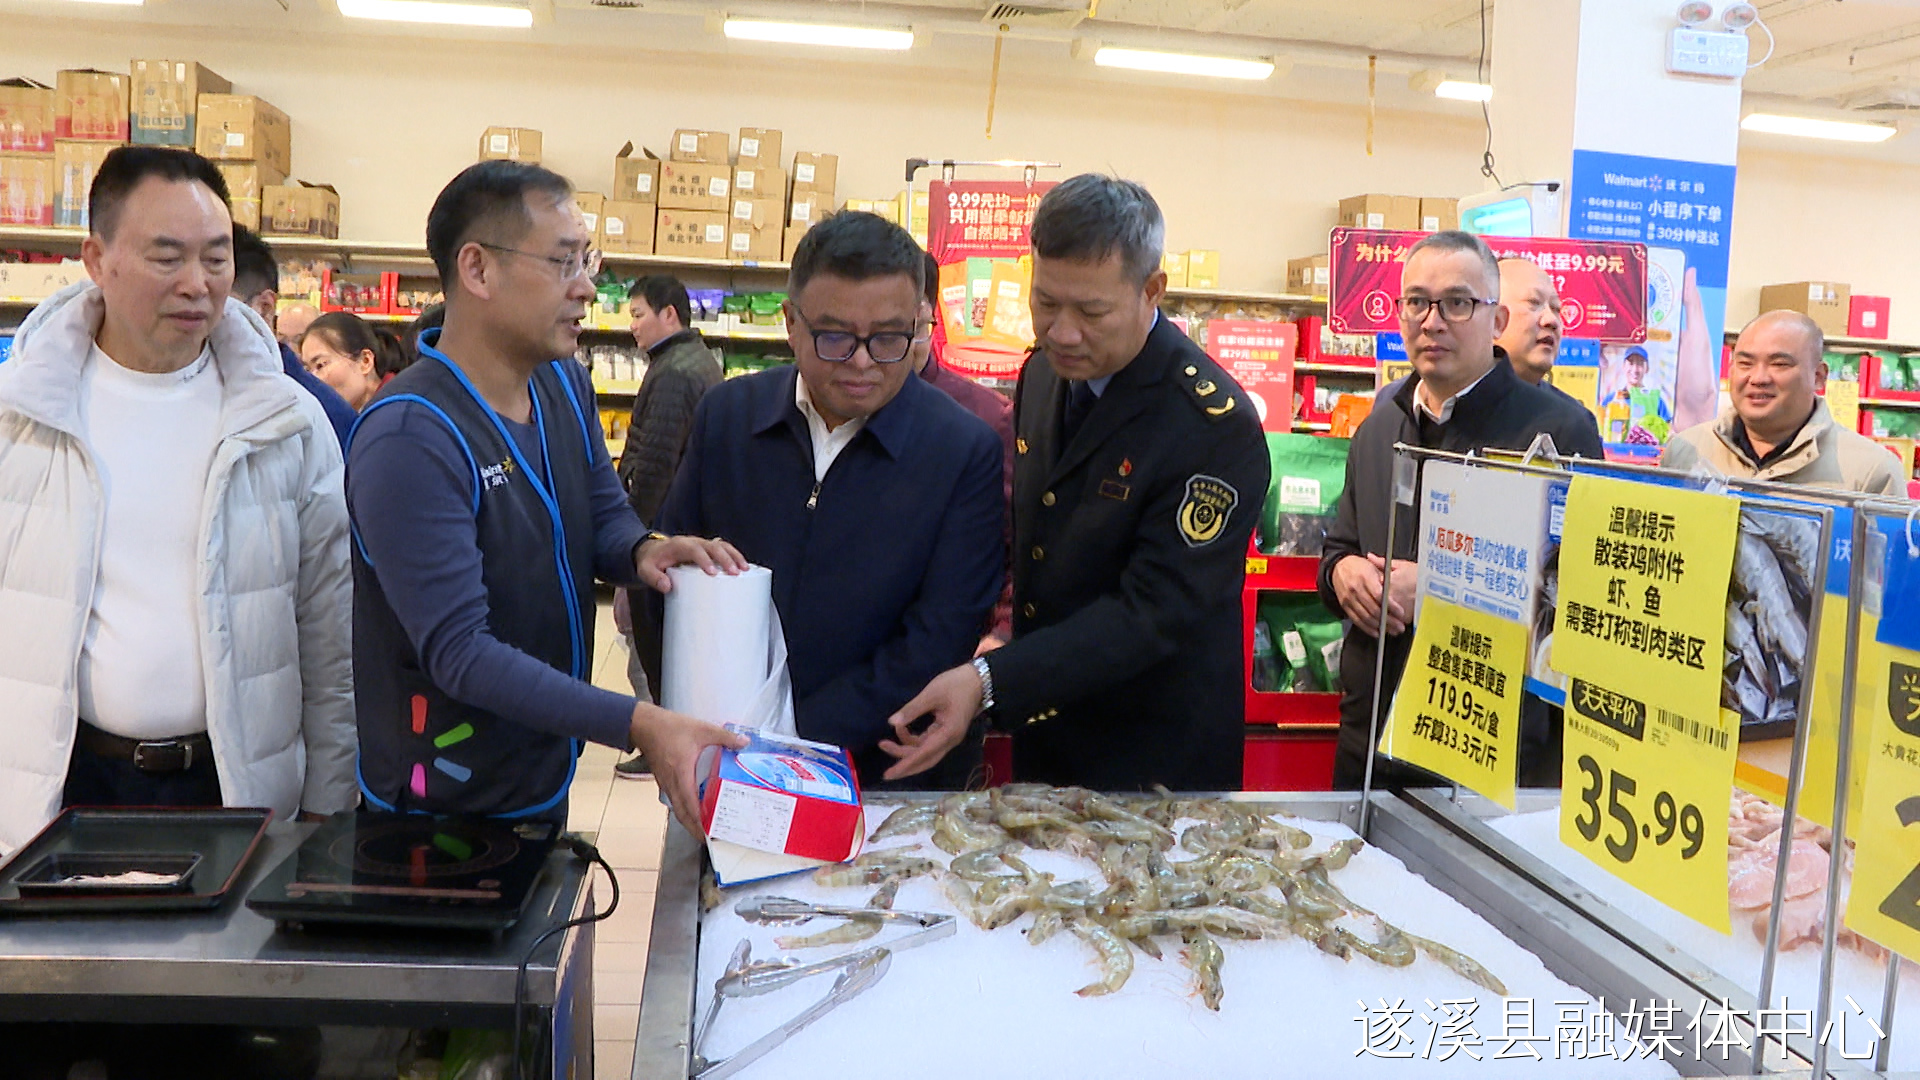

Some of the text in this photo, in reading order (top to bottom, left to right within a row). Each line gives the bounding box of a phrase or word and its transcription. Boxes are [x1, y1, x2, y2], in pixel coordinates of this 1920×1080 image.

[1603, 172, 1647, 188] Walmart
[948, 192, 1041, 209] 9.99元均一价
[1648, 199, 1722, 223] 小程序下单
[1656, 226, 1720, 246] 30分钟送达
[1608, 505, 1676, 543] 温馨提示
[1593, 535, 1685, 584] 散装鸡附件
[1449, 624, 1493, 661] 温馨提示
[1565, 600, 1707, 671] 需要打称到肉类区
[1427, 676, 1500, 739] 119.9元/盒
[1578, 682, 1640, 729] 天天平价
[1412, 713, 1498, 772] 折算33.3元/斤
[1881, 741, 1920, 771] 大黄花
[1574, 754, 1705, 864] 35.99
